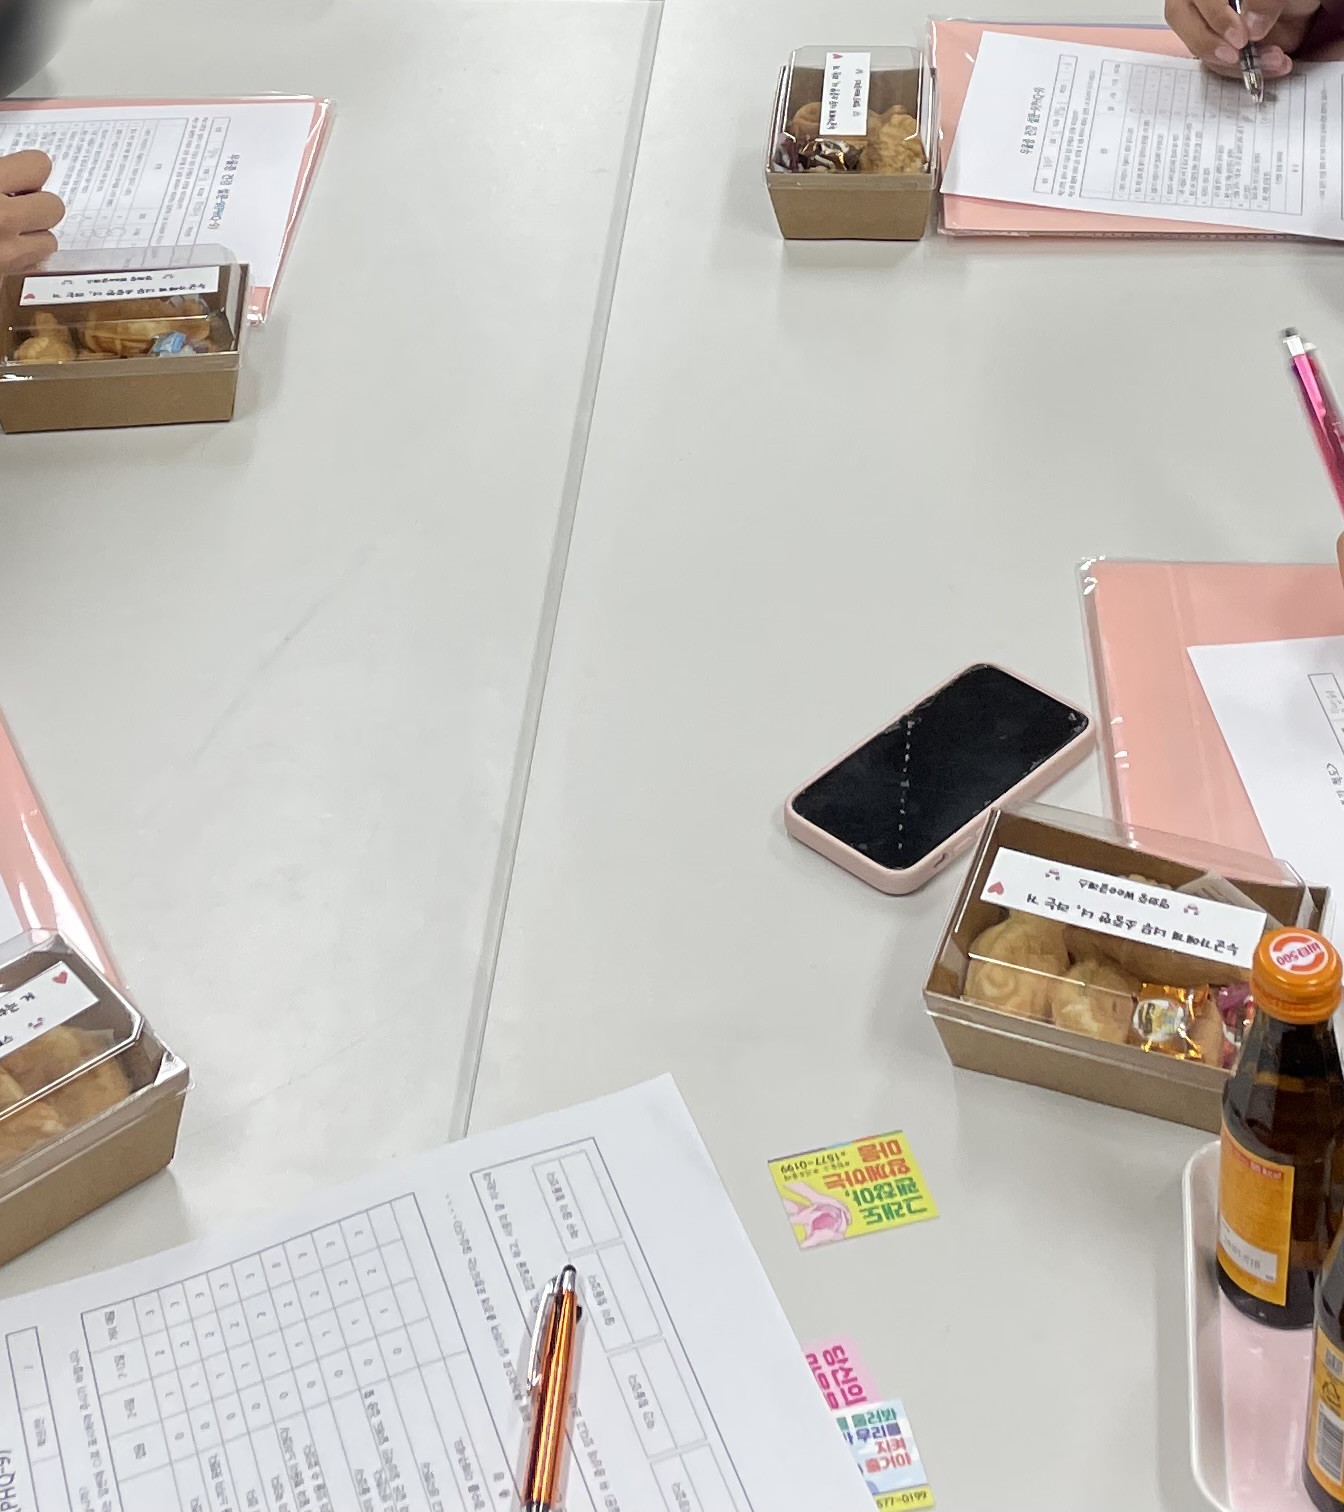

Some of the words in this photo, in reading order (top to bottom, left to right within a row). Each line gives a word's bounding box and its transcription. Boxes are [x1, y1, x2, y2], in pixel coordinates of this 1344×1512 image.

[1026, 892, 1040, 904] 거
[1098, 910, 1137, 931] 소중한
[1276, 941, 1323, 967] 비타500
[858, 1194, 928, 1226] 그래도
[822, 1344, 868, 1407] 당신의
